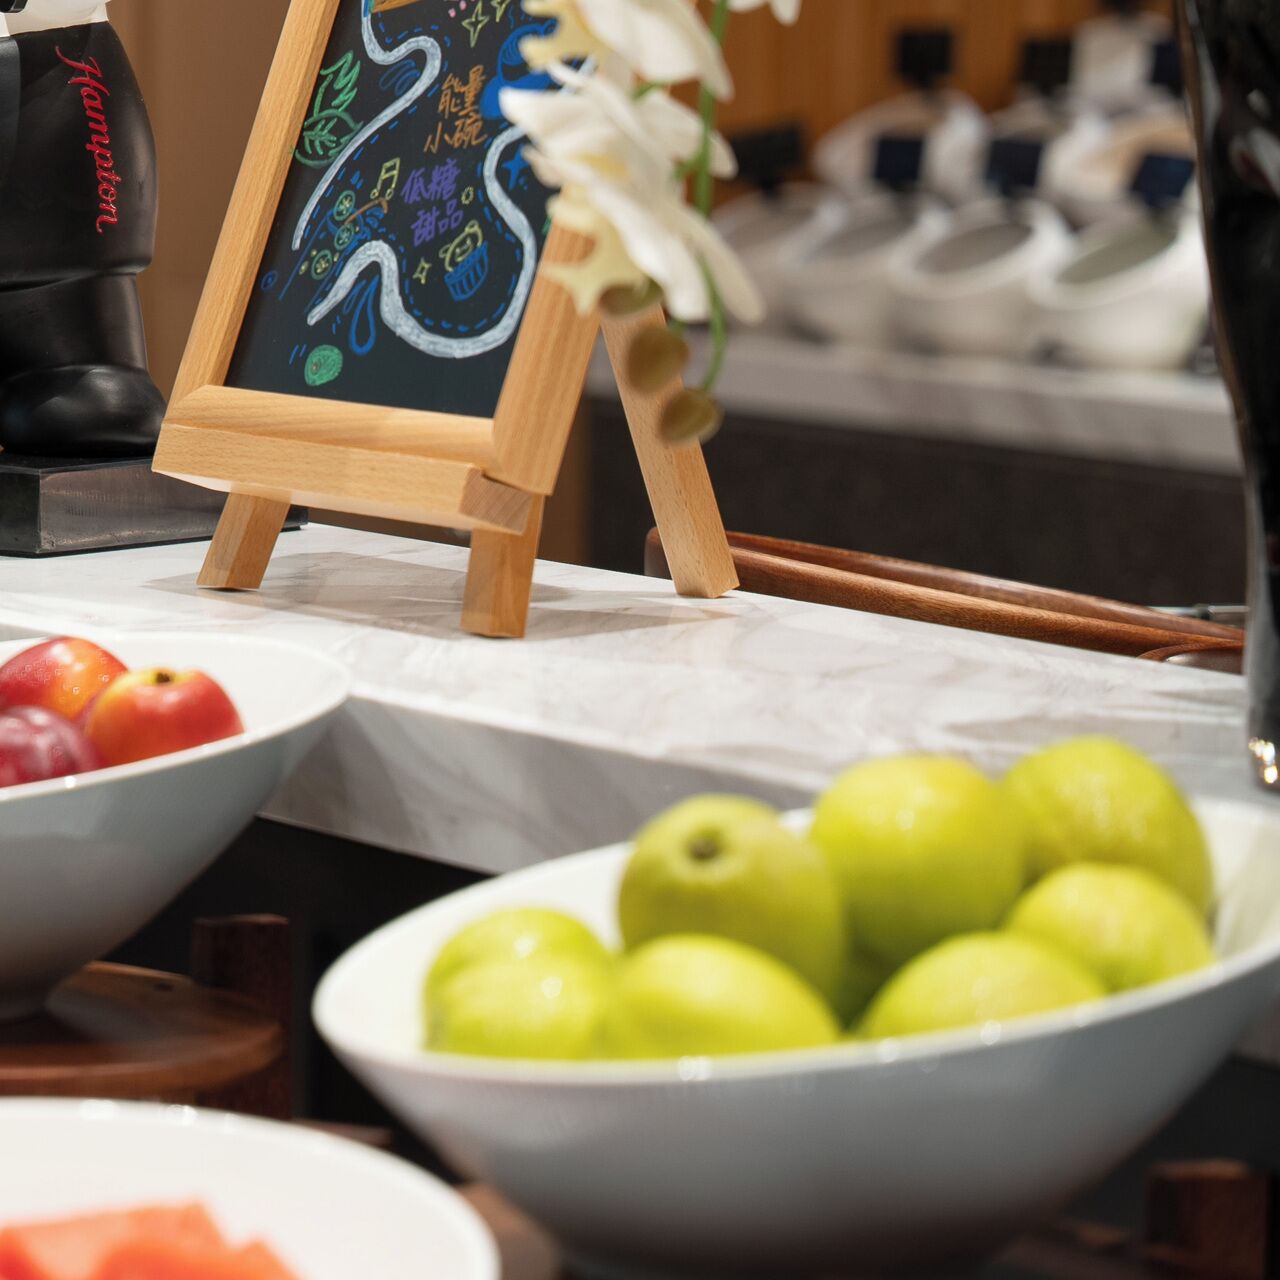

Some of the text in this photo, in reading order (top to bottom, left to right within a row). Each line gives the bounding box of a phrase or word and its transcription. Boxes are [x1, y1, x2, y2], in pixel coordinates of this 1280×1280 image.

[438, 64, 486, 119] 能量
[54, 46, 123, 235] Hampton
[424, 113, 488, 155] 小碗
[400, 158, 461, 205] 低糖
[410, 198, 464, 247] 甜品
